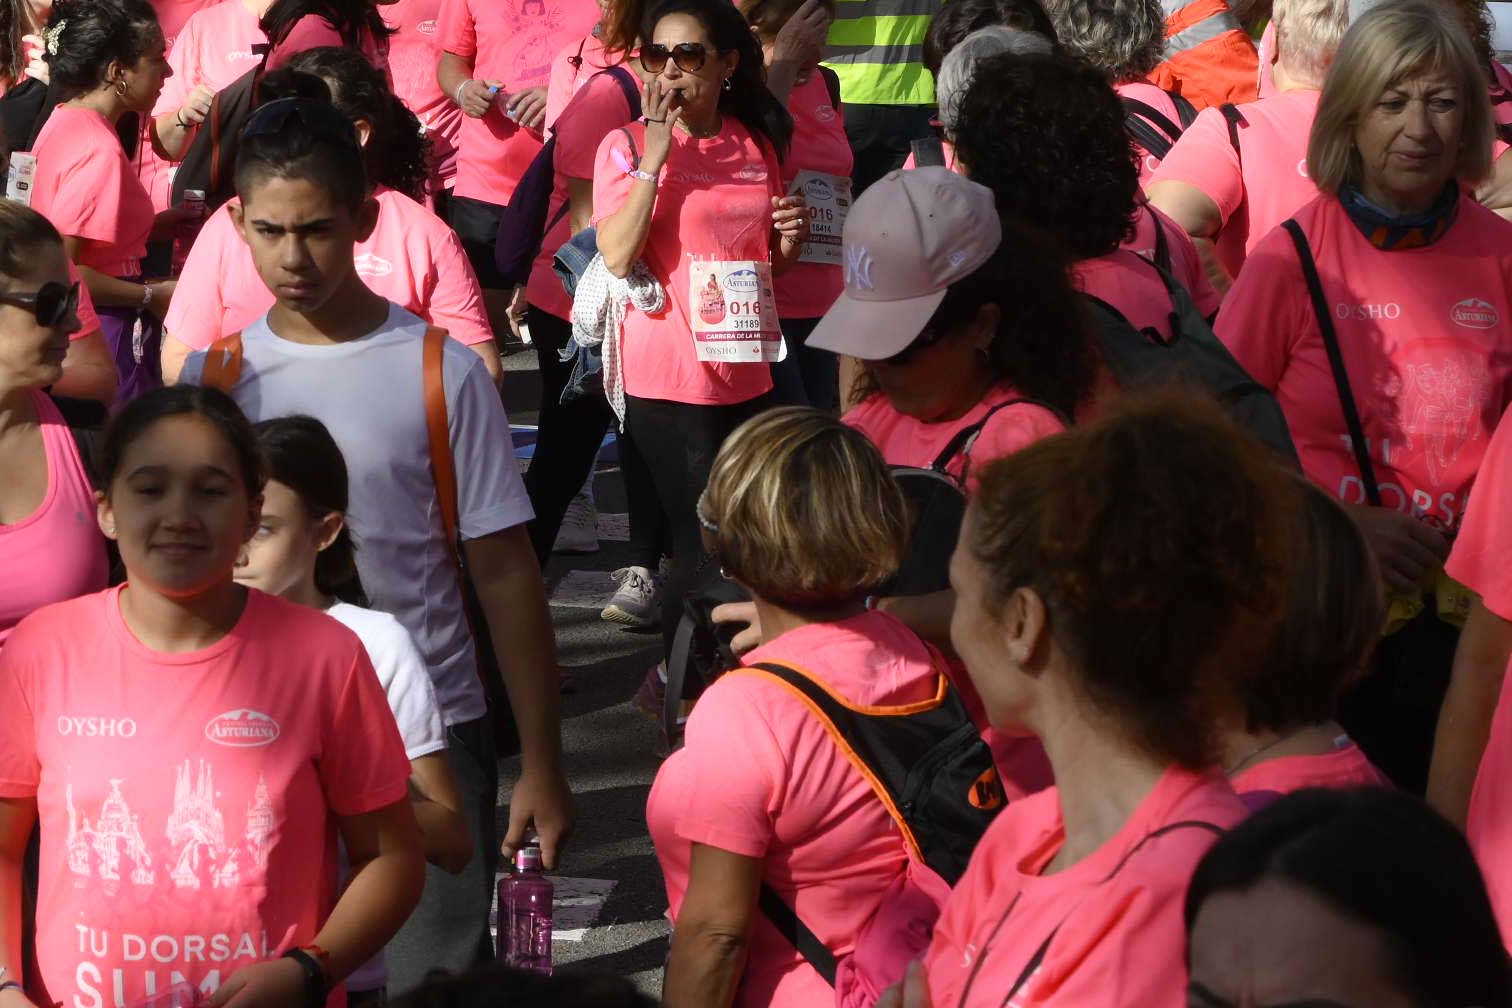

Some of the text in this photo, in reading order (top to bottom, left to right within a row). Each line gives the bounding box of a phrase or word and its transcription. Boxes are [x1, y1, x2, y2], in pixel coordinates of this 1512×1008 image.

[809, 206, 833, 221] 016
[706, 332, 735, 340] CARRERA
[57, 715, 137, 738] OYSHO
[211, 720, 274, 737] ASTURIANA
[75, 923, 108, 958] TU
